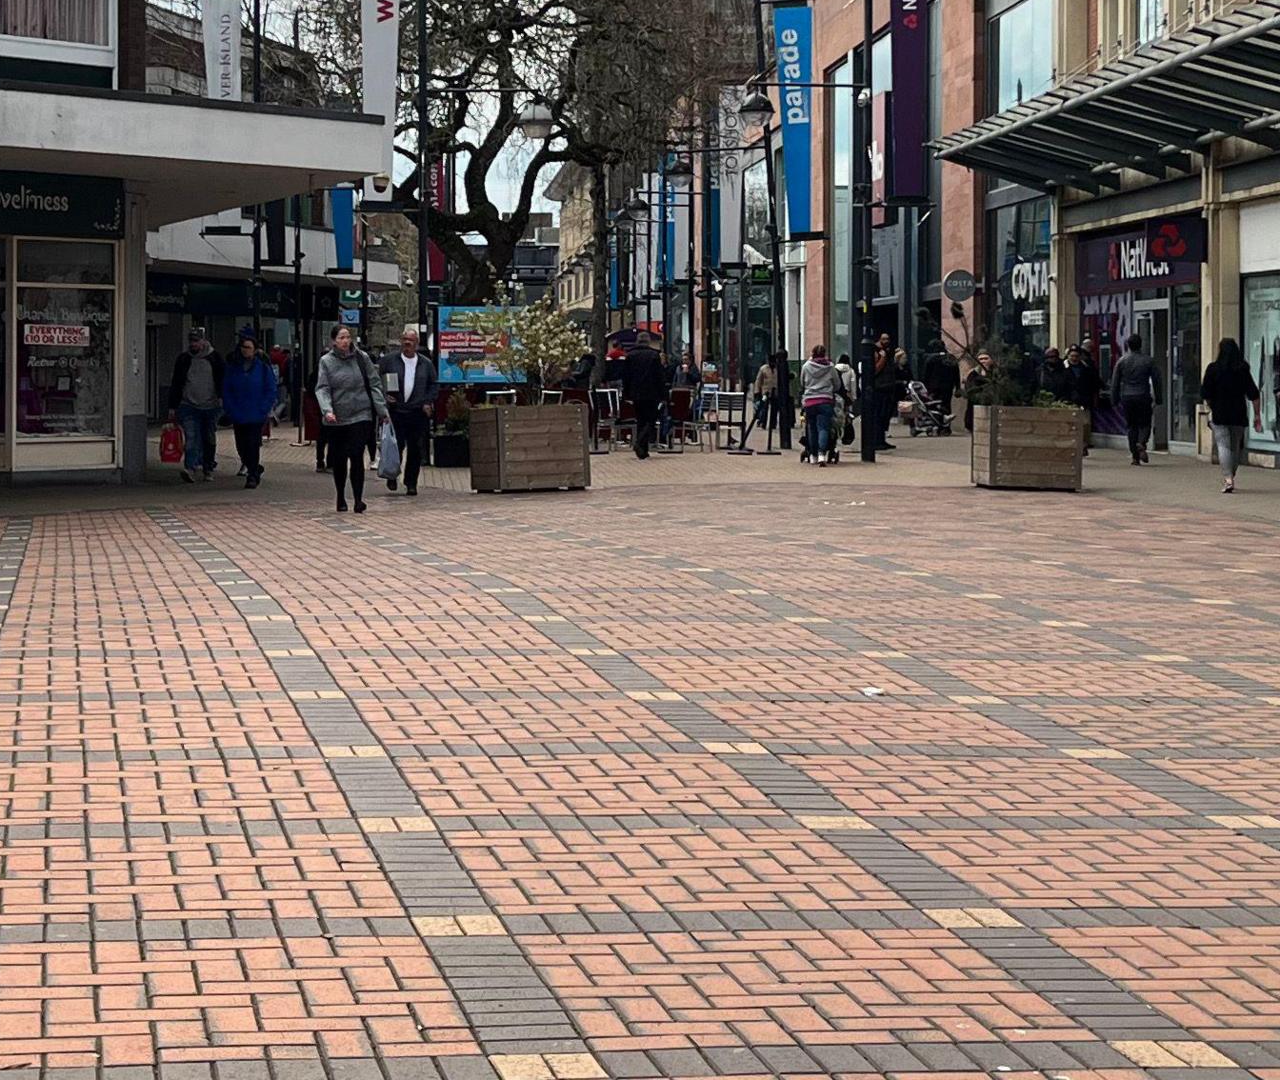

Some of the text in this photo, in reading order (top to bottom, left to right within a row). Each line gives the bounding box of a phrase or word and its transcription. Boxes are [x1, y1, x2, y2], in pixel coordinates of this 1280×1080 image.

[220, 14, 231, 98] VER ISLAND
[781, 29, 810, 125] parade
[946, 279, 974, 287] COSTA
[29, 325, 85, 336] EVERYTHING
